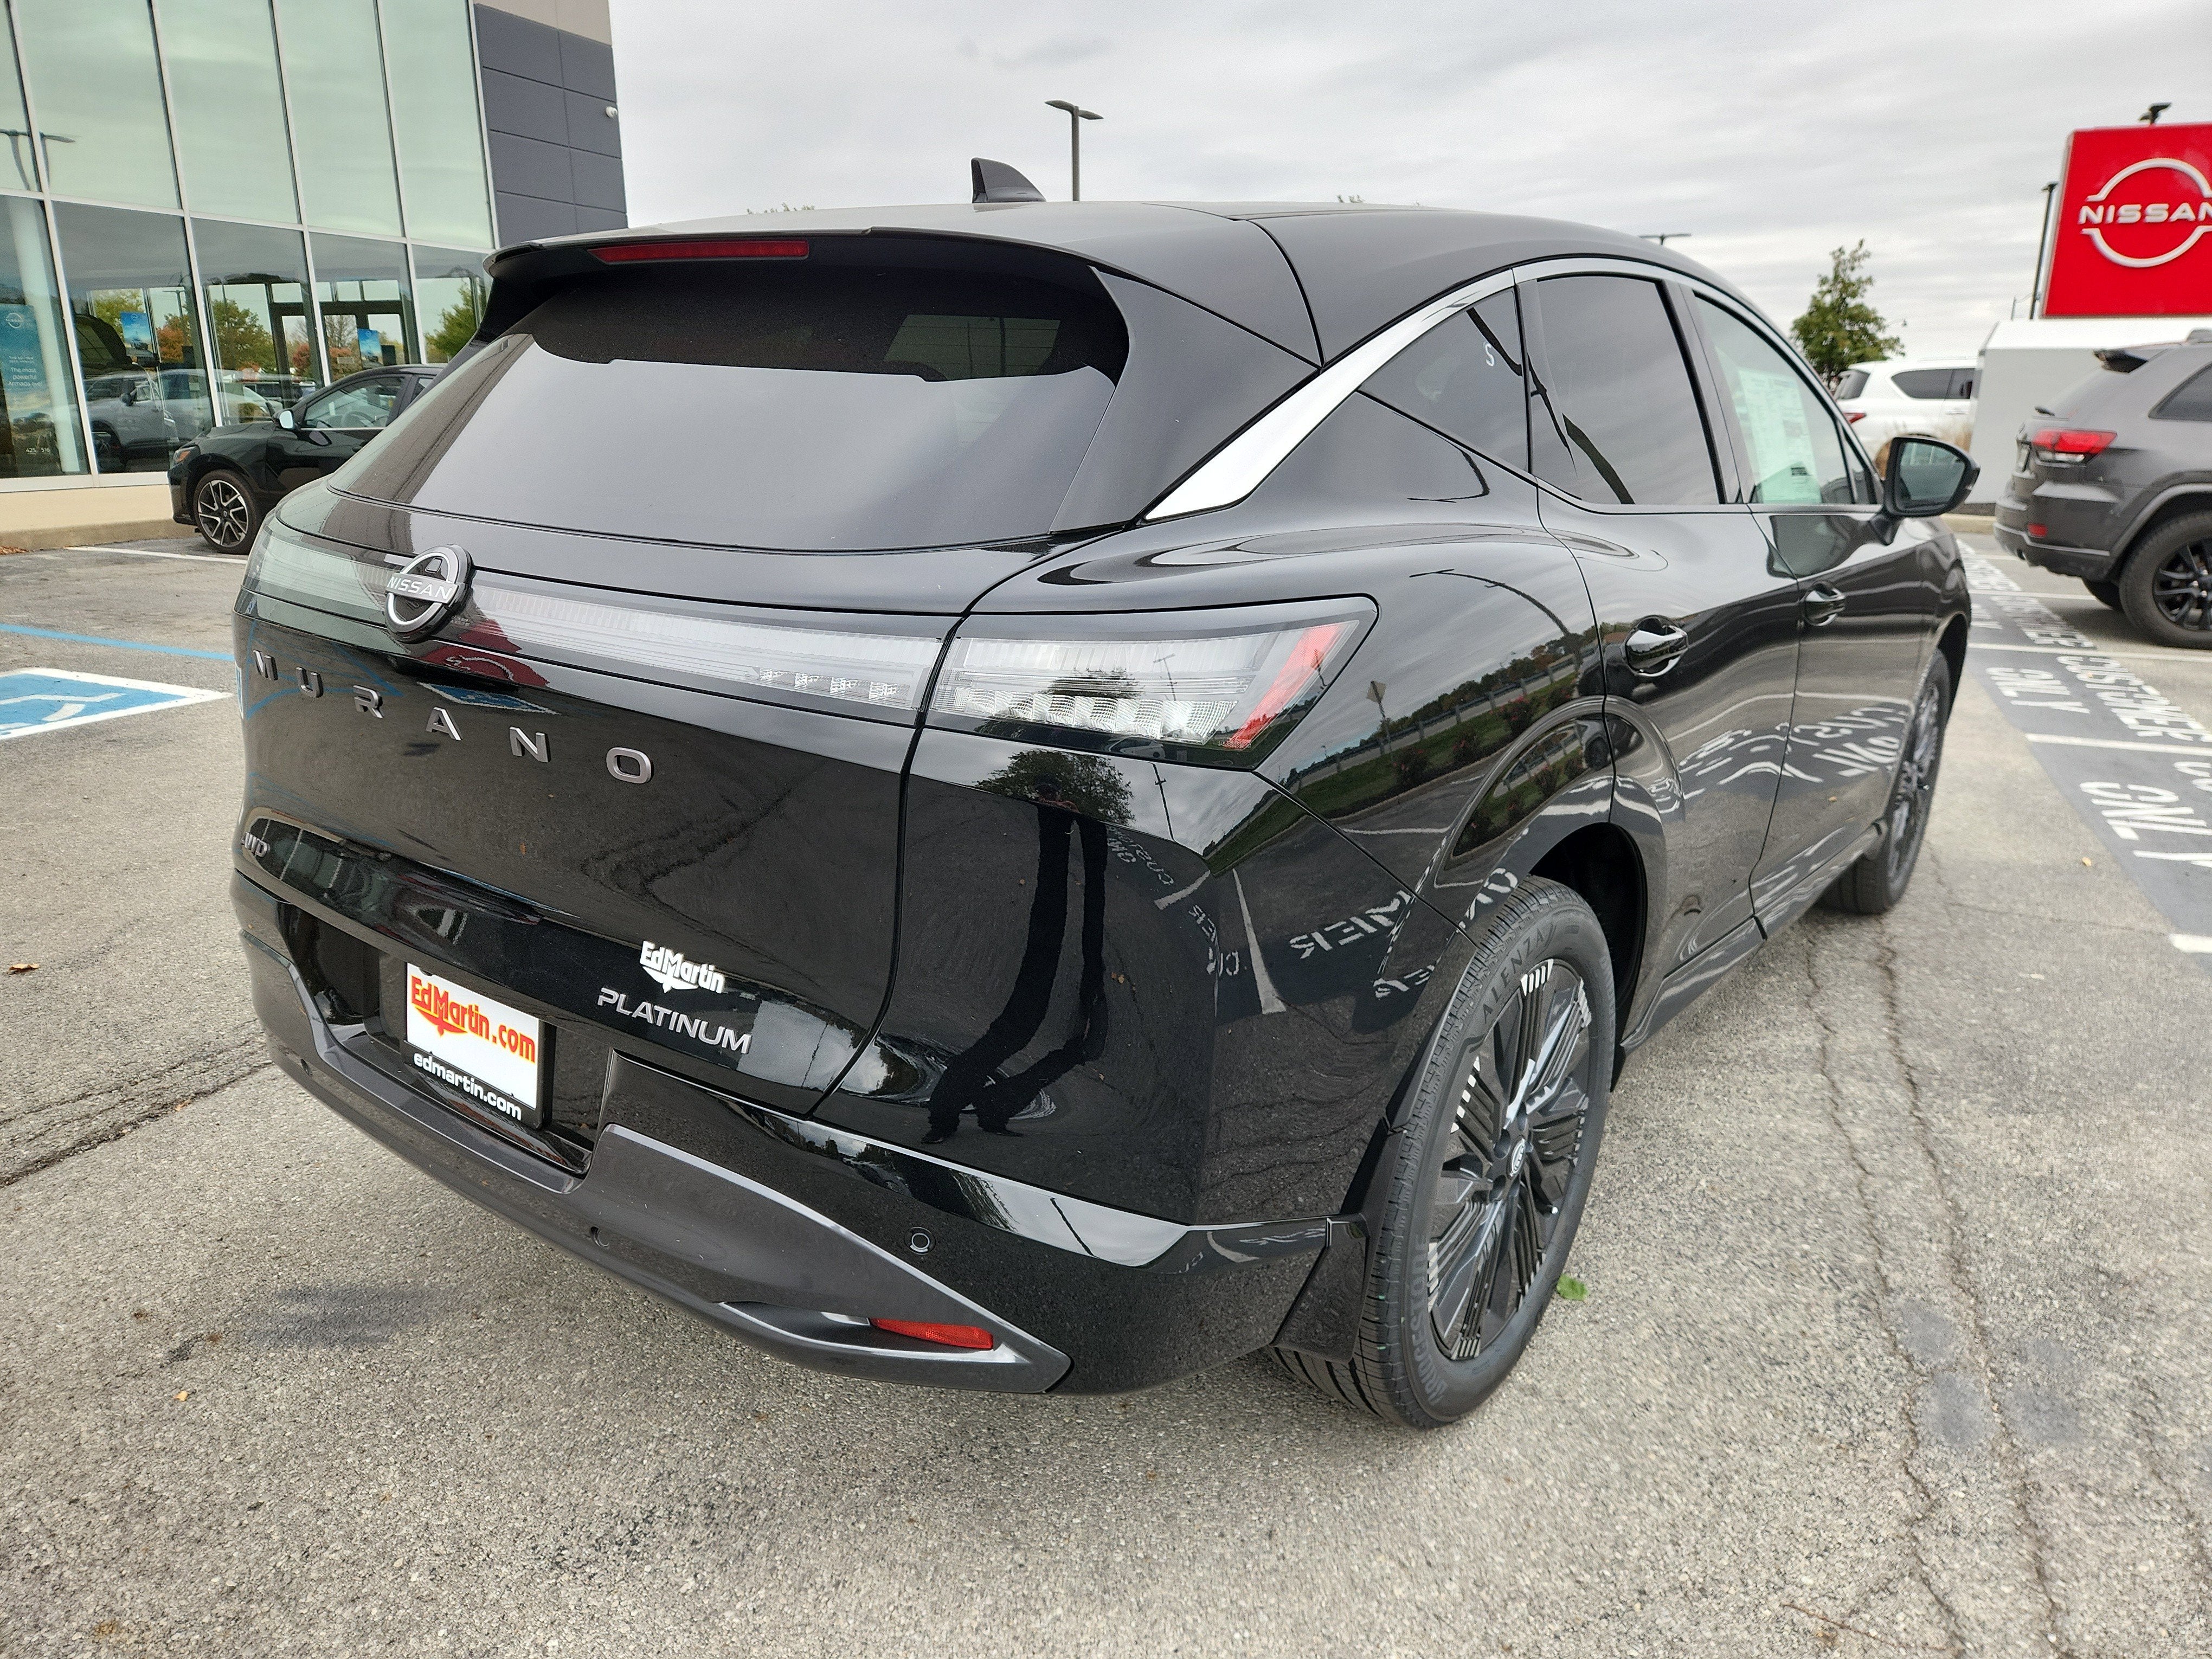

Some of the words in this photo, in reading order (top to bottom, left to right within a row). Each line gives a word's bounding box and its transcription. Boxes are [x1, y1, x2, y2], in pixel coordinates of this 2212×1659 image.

[387, 575, 452, 600] NISSAN
[253, 649, 653, 785] MURANO
[597, 988, 752, 1054] PLATINUM
[413, 1052, 522, 1121] edmartin.com
